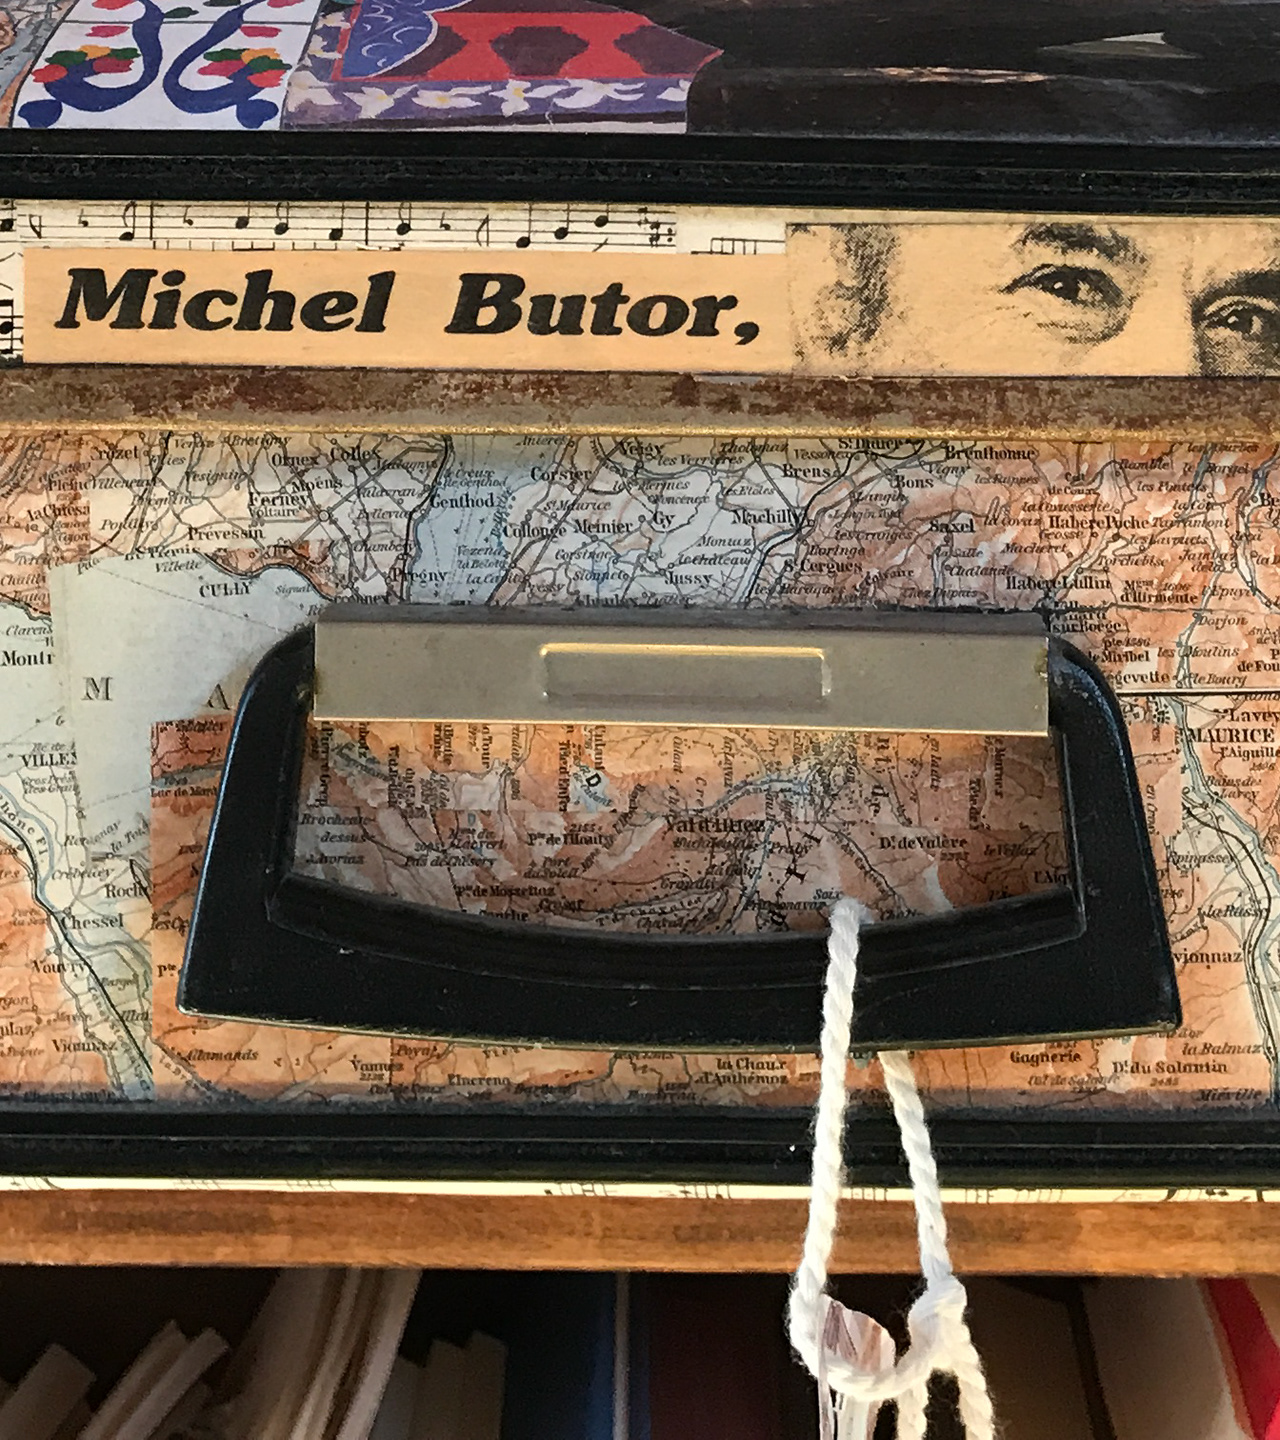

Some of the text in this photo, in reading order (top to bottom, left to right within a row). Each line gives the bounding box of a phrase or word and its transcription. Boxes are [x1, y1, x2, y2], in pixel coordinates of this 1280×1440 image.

[56, 266, 762, 348] Michel Butor,
[330, 448, 381, 461] Collex
[620, 442, 662, 460] Veigy
[947, 446, 1036, 460] Brenthonne
[272, 455, 318, 467] Ornex
[531, 468, 591, 481] Corsier
[783, 464, 830, 477] Brens
[895, 476, 934, 488] Bons
[250, 493, 310, 507] Ferney
[430, 494, 494, 508] Genthod
[248, 508, 299, 517] Voltaire
[732, 510, 799, 525] Machilly
[574, 520, 633, 533] Meinier
[653, 513, 676, 528] Gy
[929, 520, 975, 533] Saxel
[1106, 516, 1150, 529] Poche
[801, 560, 863, 575] Cergues
[393, 568, 447, 584] Pregny
[665, 572, 711, 587] Jussy
[200, 583, 251, 598] CULLY
[1061, 577, 1111, 590] Lullin
[1182, 646, 1239, 658] Moulins
[1229, 709, 1280, 723] Lavey
[1190, 728, 1274, 743] MAURICE
[62, 913, 124, 928] Chessel
[1173, 950, 1243, 963] vionnaz
[32, 960, 87, 976] Vouvry
[1204, 1042, 1261, 1055] Balmaz
[1010, 1050, 1081, 1066] Gagnerie
